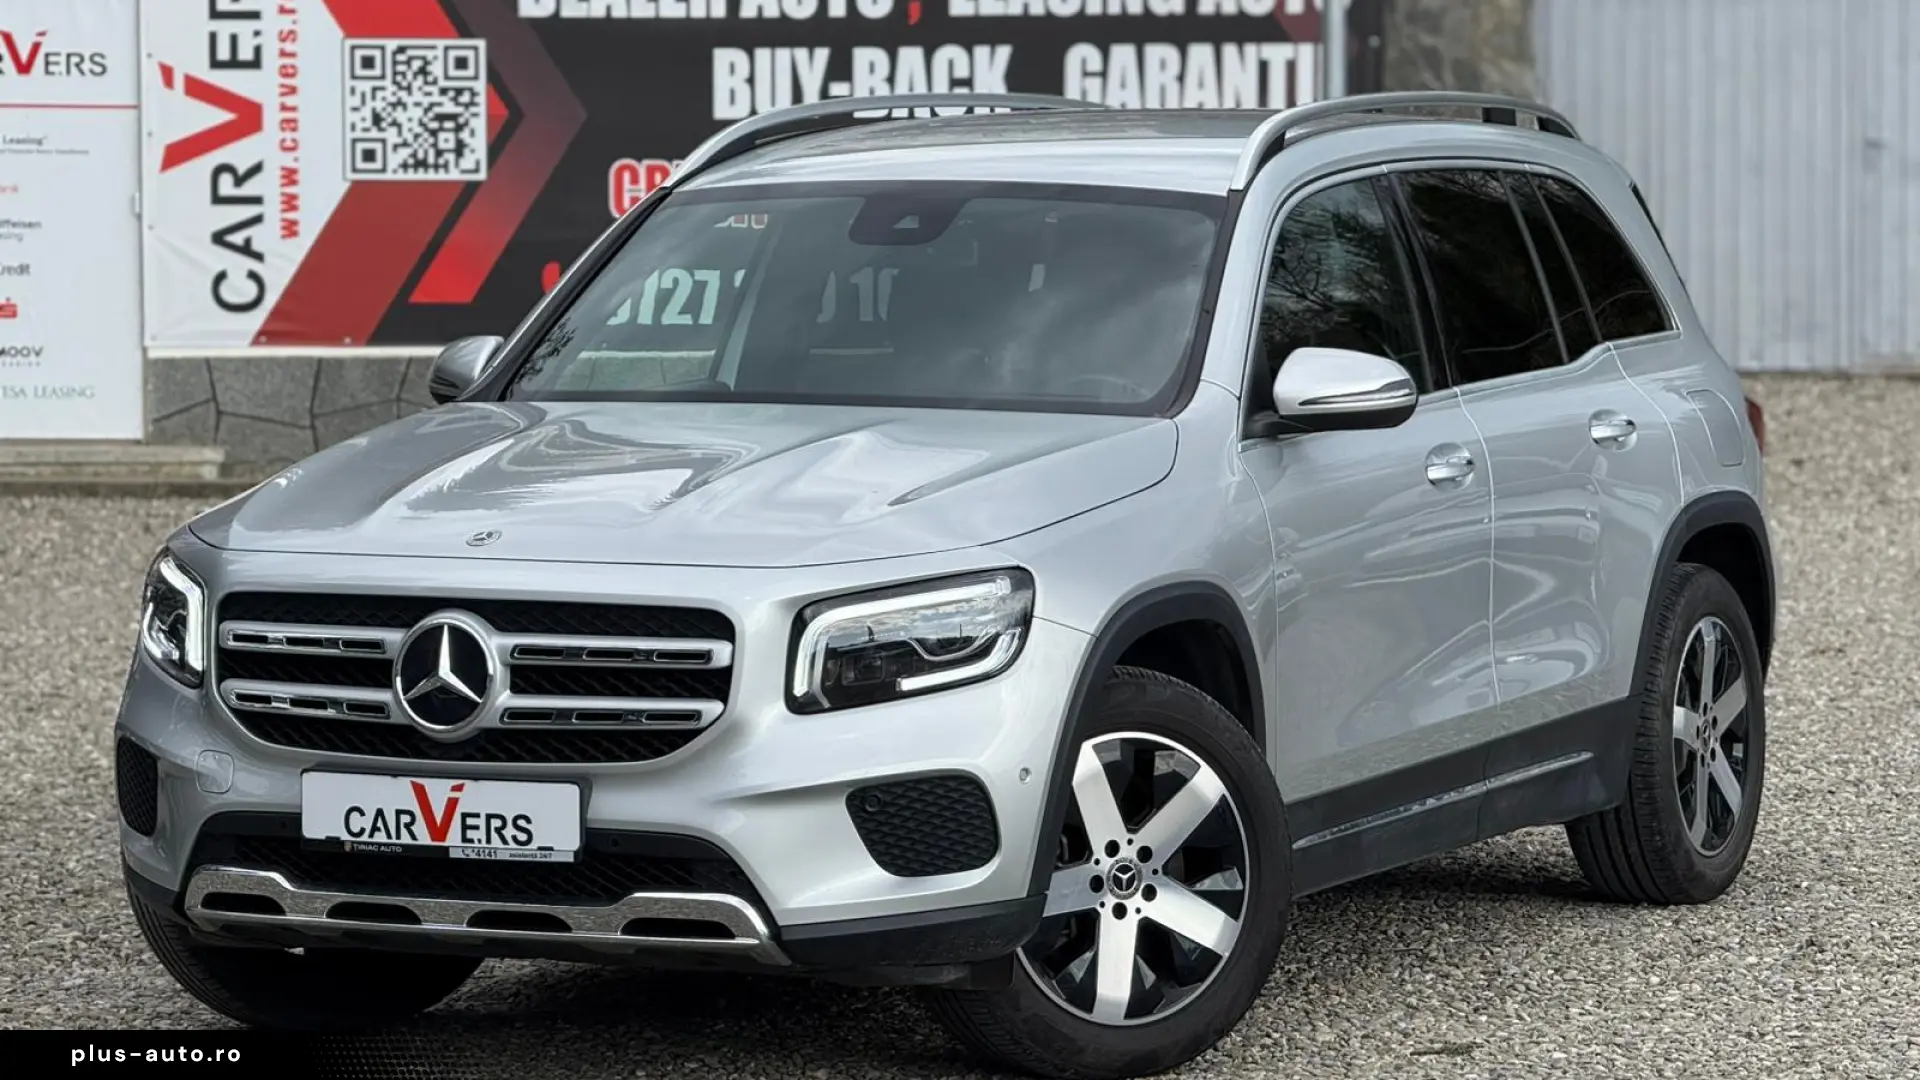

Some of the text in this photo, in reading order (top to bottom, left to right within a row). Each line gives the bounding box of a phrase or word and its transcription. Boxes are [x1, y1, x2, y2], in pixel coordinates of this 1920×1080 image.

[0, 29, 108, 77] VERS
[712, 42, 1324, 120] BUY-BACK GARANTI
[344, 780, 534, 847] CARVERS
[379, 845, 403, 853] AUTO
